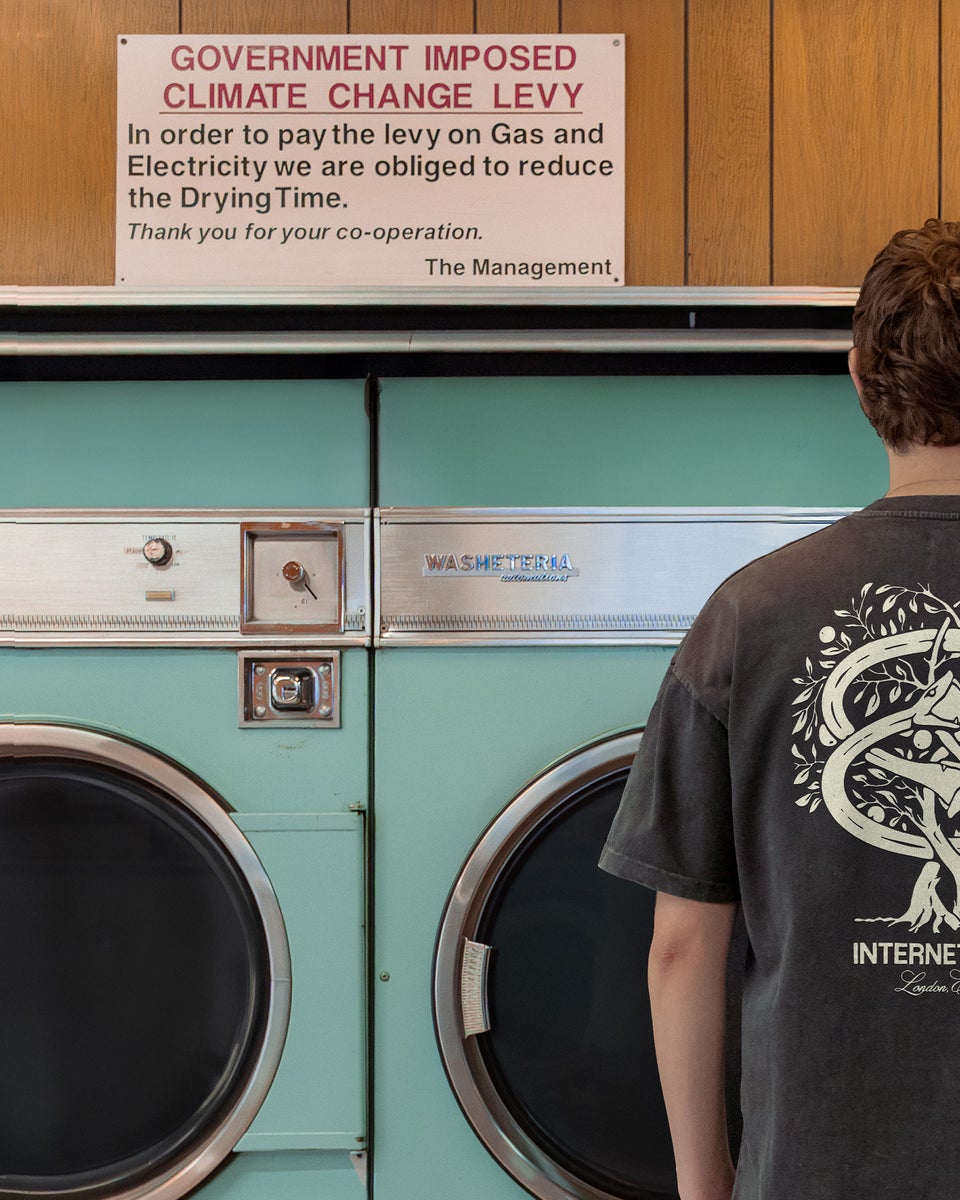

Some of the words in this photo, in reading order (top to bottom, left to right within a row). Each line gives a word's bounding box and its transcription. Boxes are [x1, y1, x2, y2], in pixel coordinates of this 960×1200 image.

[171, 44, 409, 72] GOVERNMENT
[424, 44, 577, 72] IMPOSED
[163, 82, 307, 109] CLIMATE
[328, 82, 472, 109] CHANGE
[493, 82, 584, 109] LEVY
[128, 123, 150, 145] In
[160, 123, 234, 145] order
[243, 124, 269, 145] to
[278, 127, 327, 151] pay
[332, 123, 375, 145] the
[385, 123, 441, 150] levy
[448, 127, 481, 145] on
[491, 122, 544, 145] Gas
[554, 122, 604, 145] and
[128, 155, 268, 183] Electricity
[274, 159, 312, 177] we
[321, 159, 365, 177] are
[375, 154, 476, 183] obliged
[483, 156, 510, 177] to
[519, 154, 614, 177] reduce
[128, 187, 171, 208] the
[181, 186, 272, 214] Drying
[275, 186, 348, 208] Time.
[128, 222, 193, 240] Thank
[197, 226, 237, 244] you
[245, 222, 277, 240] for
[280, 226, 331, 244] your
[336, 222, 483, 244] co-operation.
[425, 258, 465, 276] The
[473, 258, 612, 280] Management
[424, 553, 574, 572] WASHETERIA
